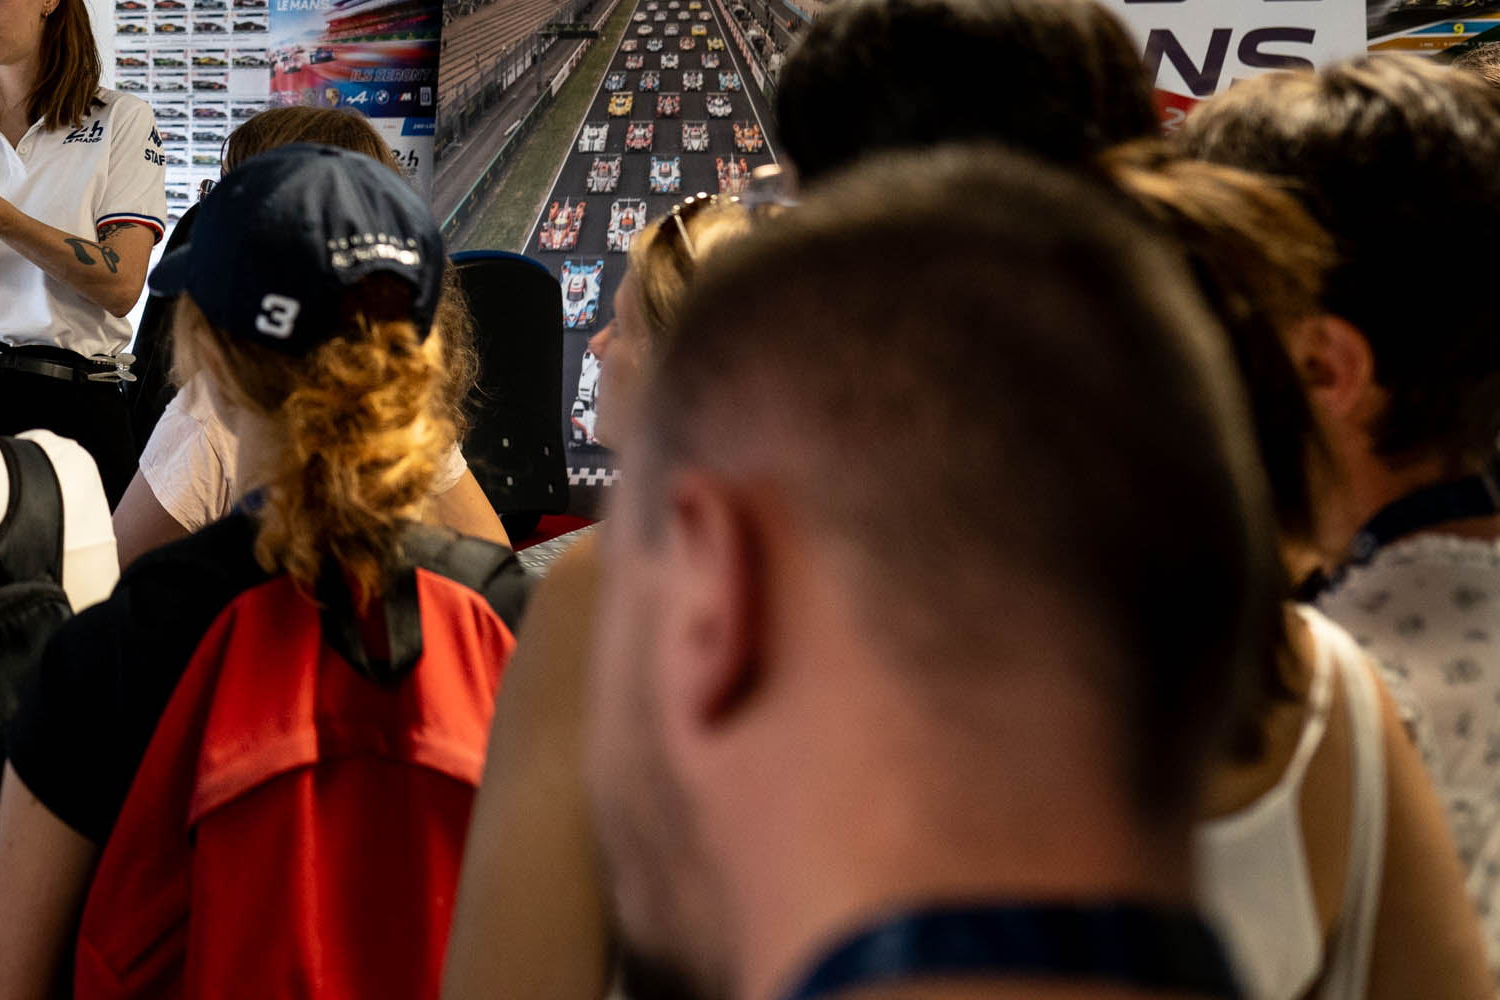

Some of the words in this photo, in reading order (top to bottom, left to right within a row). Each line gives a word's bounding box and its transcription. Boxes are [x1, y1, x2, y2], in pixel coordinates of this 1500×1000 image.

[276, 1, 291, 11] LE
[291, 0, 331, 11] MANS
[1453, 23, 1465, 36] 9
[1143, 27, 1316, 97] NS
[144, 148, 166, 166] STAF
[254, 293, 300, 339] 3
